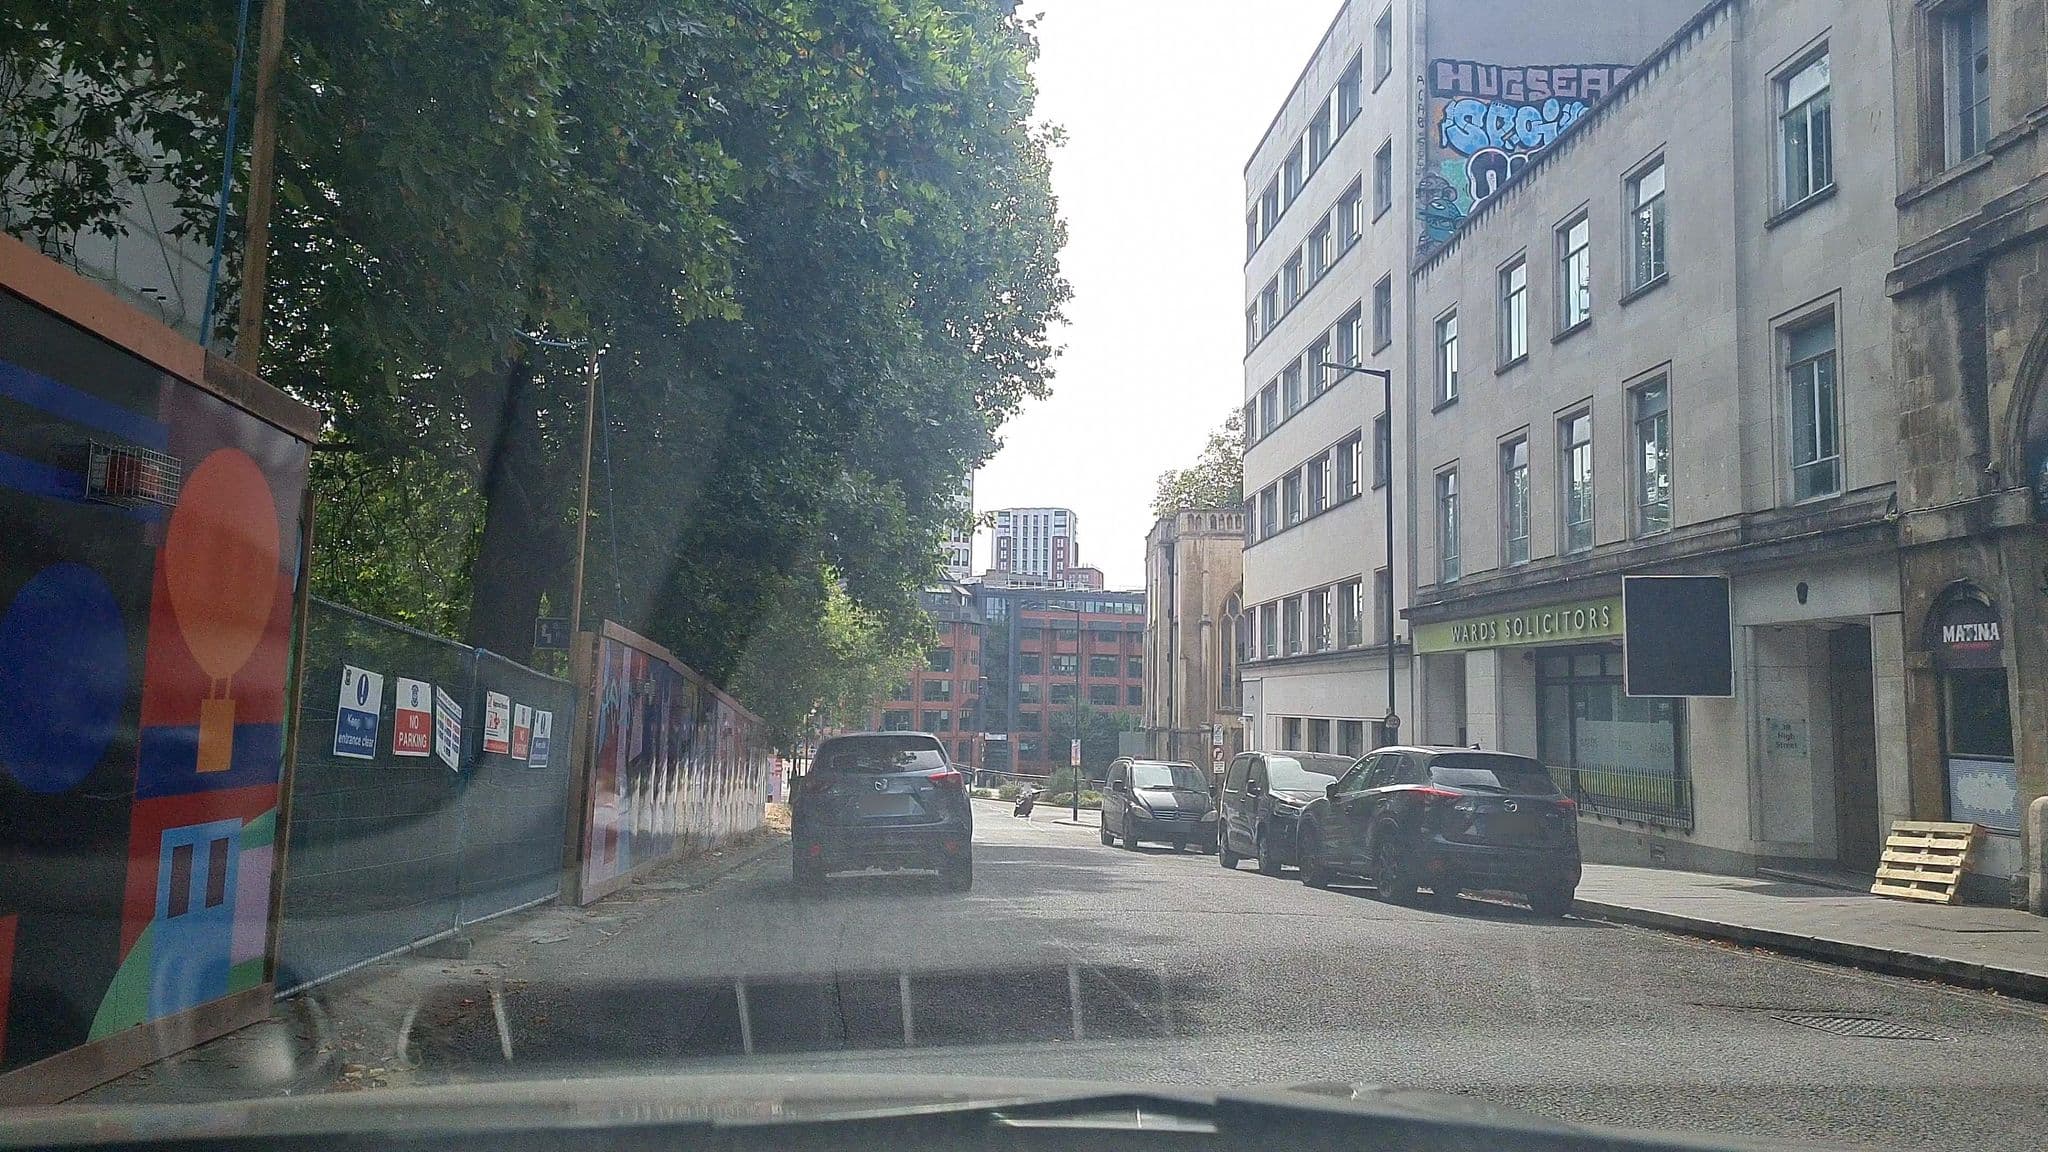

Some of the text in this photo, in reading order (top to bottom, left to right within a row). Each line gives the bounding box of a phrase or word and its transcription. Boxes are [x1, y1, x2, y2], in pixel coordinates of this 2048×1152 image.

[1451, 605, 1610, 643] WARDS SOLICITORS
[1942, 622, 2001, 643] MATINA
[408, 714, 420, 729] NO
[338, 731, 375, 748] entrance clear
[398, 731, 428, 748] PARKING
